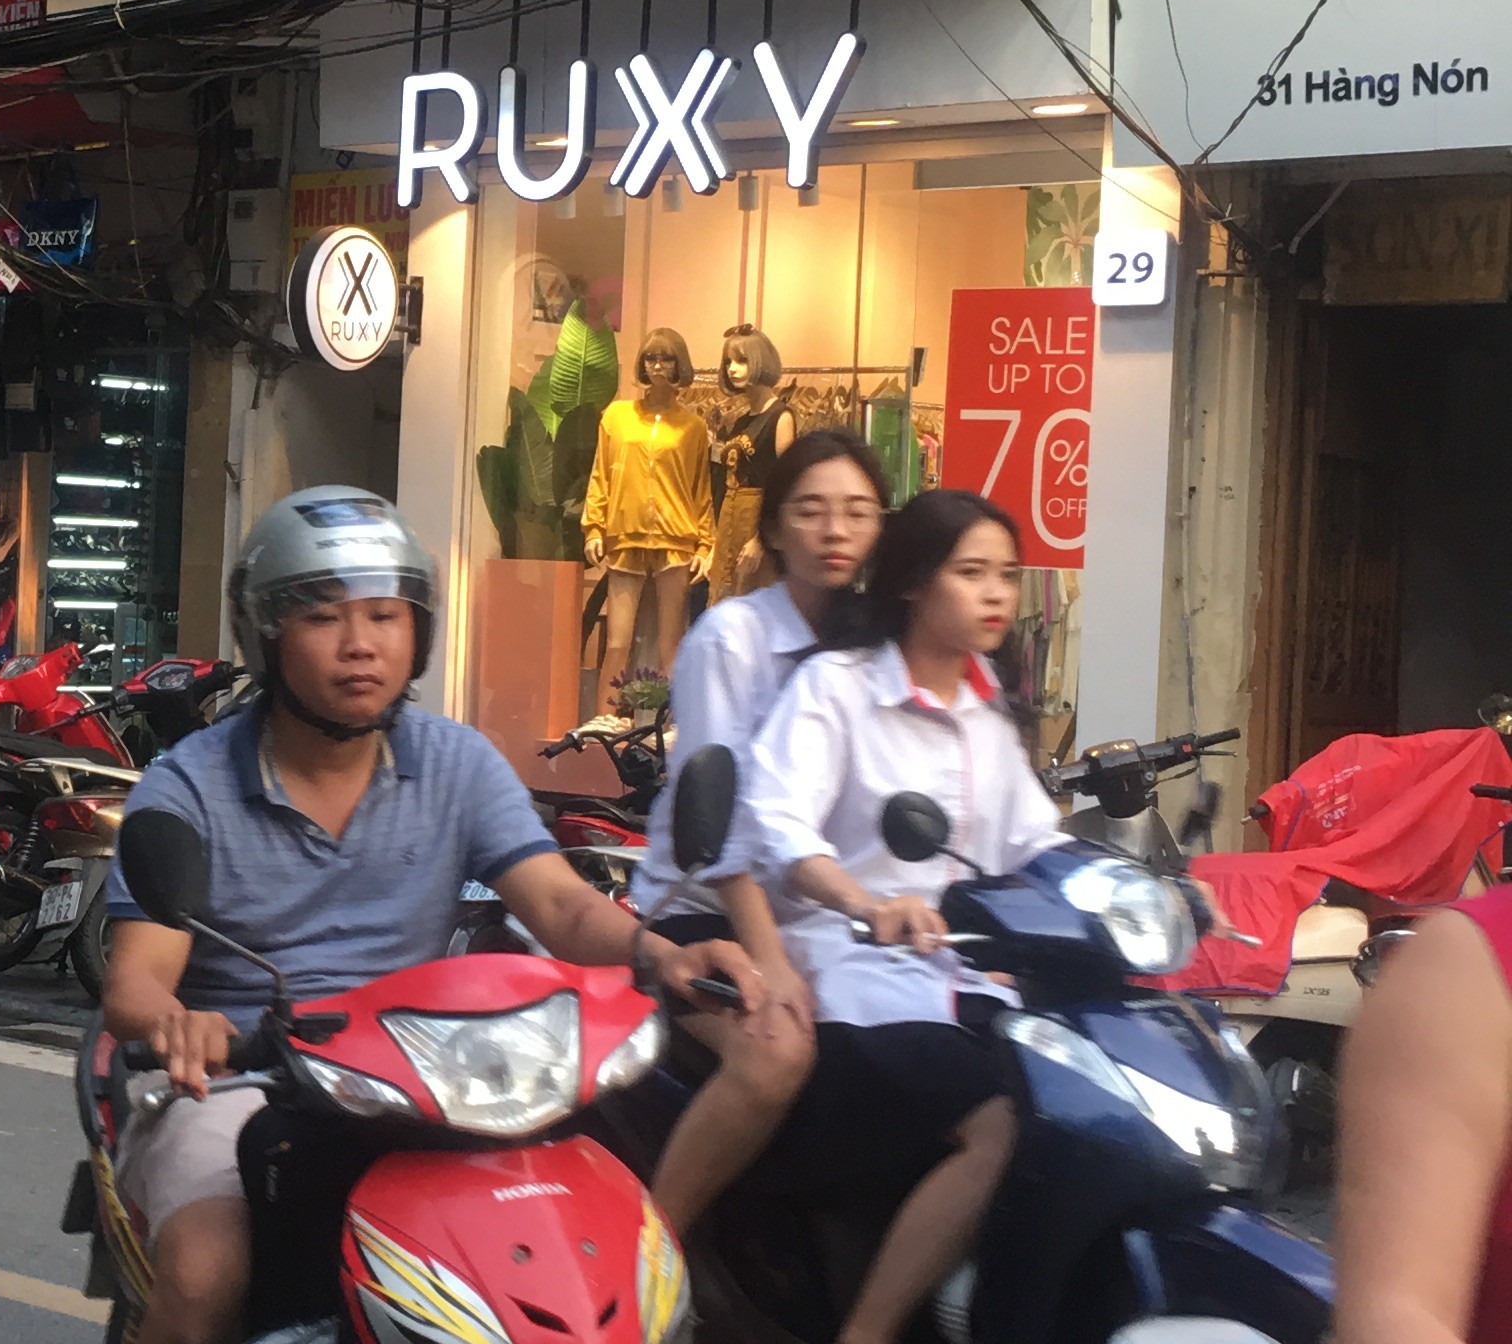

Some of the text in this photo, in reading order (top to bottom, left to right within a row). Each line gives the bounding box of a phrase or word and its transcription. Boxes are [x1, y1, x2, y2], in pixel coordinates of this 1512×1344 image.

[1255, 60, 1489, 108] 31 Hàng Nón
[398, 32, 864, 209] RUXY
[27, 229, 80, 247] DKNY
[1107, 251, 1155, 284] 29
[331, 320, 383, 343] RUXY
[988, 316, 1088, 355] SALE
[988, 363, 1086, 394] UP TO
[491, 1182, 574, 1202] HONDA
